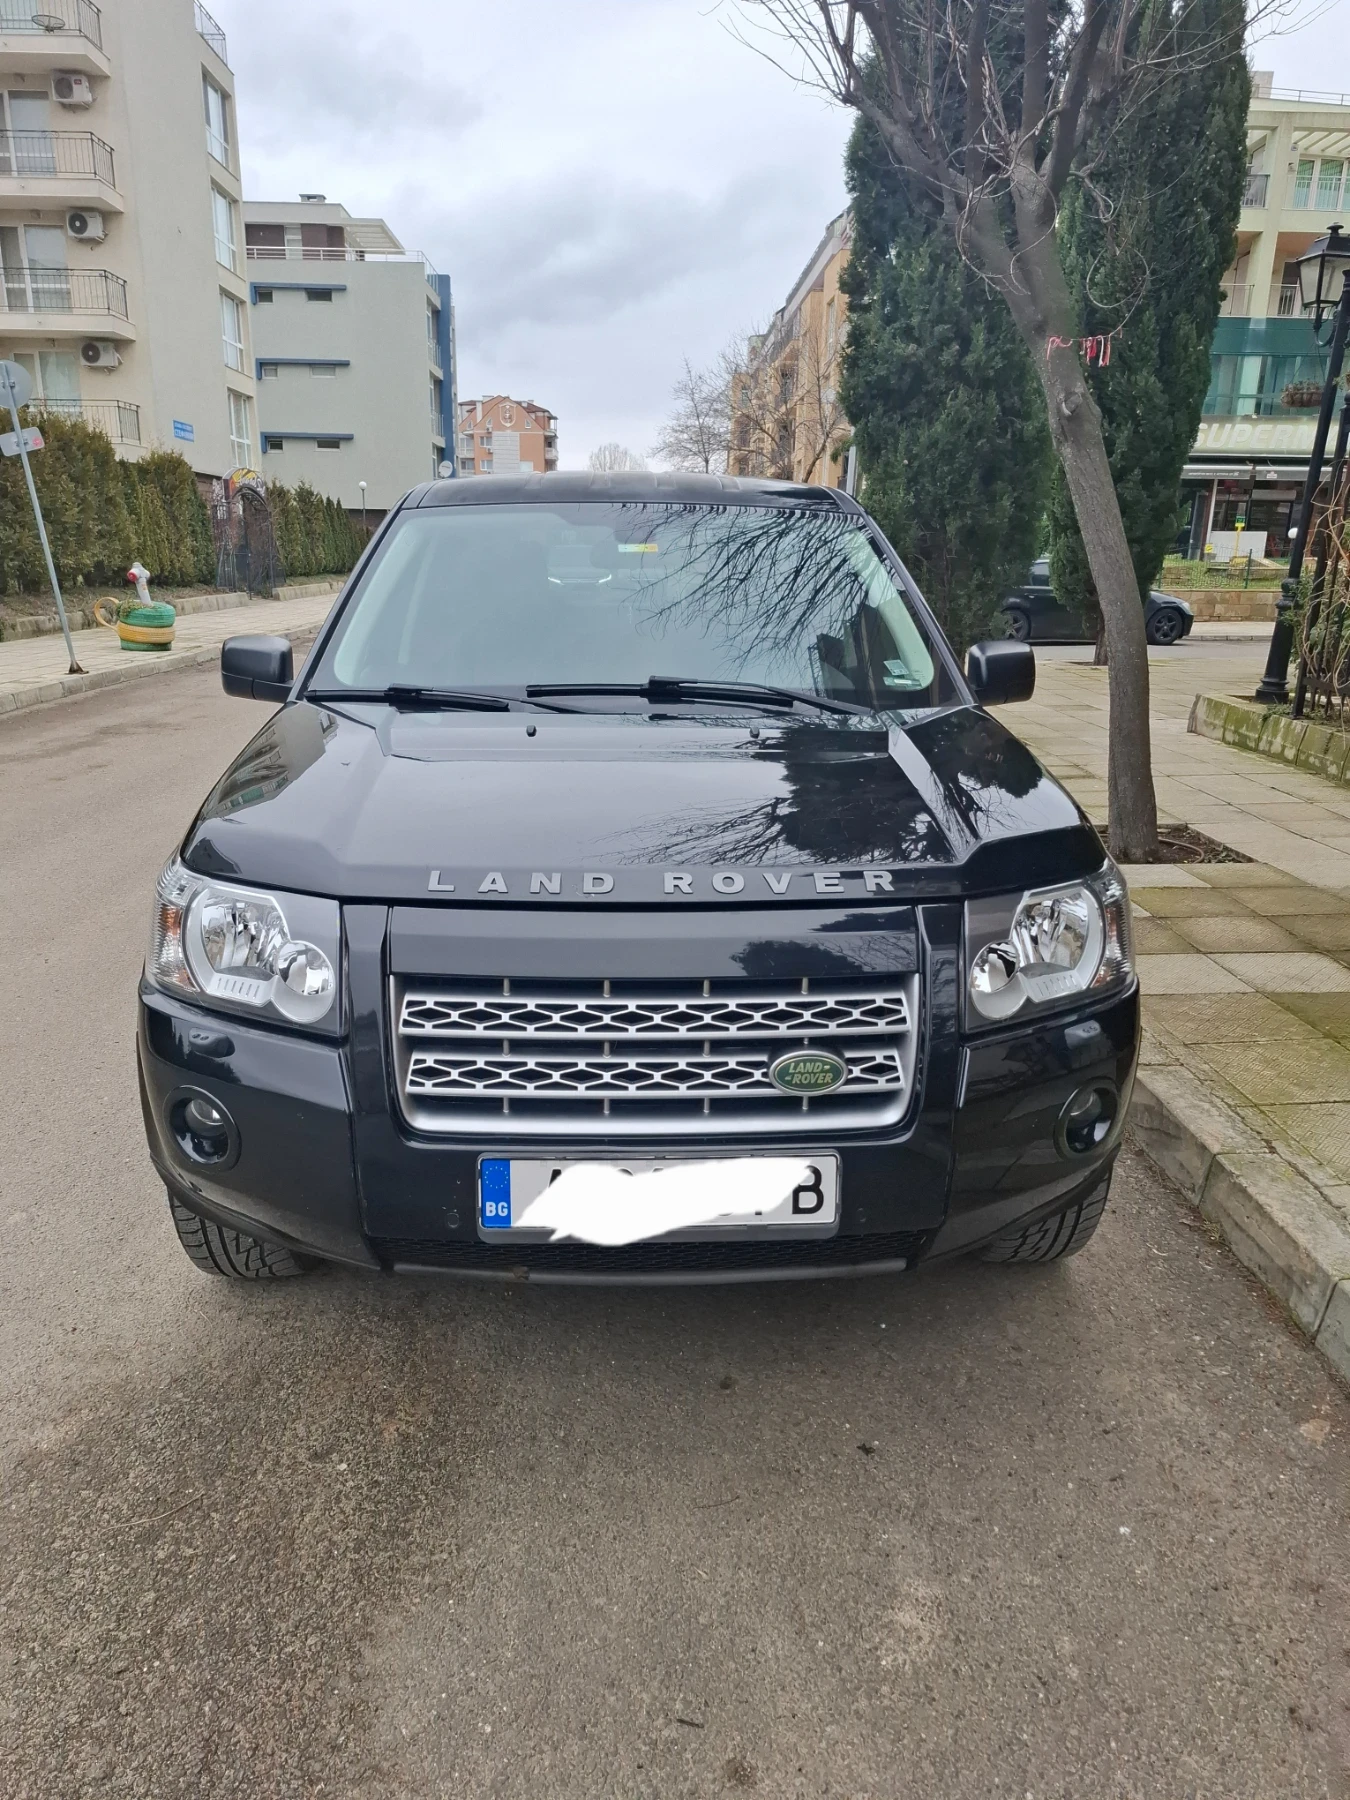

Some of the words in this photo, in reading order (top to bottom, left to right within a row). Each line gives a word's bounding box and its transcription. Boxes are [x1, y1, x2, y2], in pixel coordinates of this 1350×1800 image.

[427, 870, 615, 894] LAND
[663, 870, 895, 894] ROVER
[788, 1062, 823, 1073] LAND
[791, 1073, 834, 1084] ROVER
[485, 1201, 509, 1217] BG
